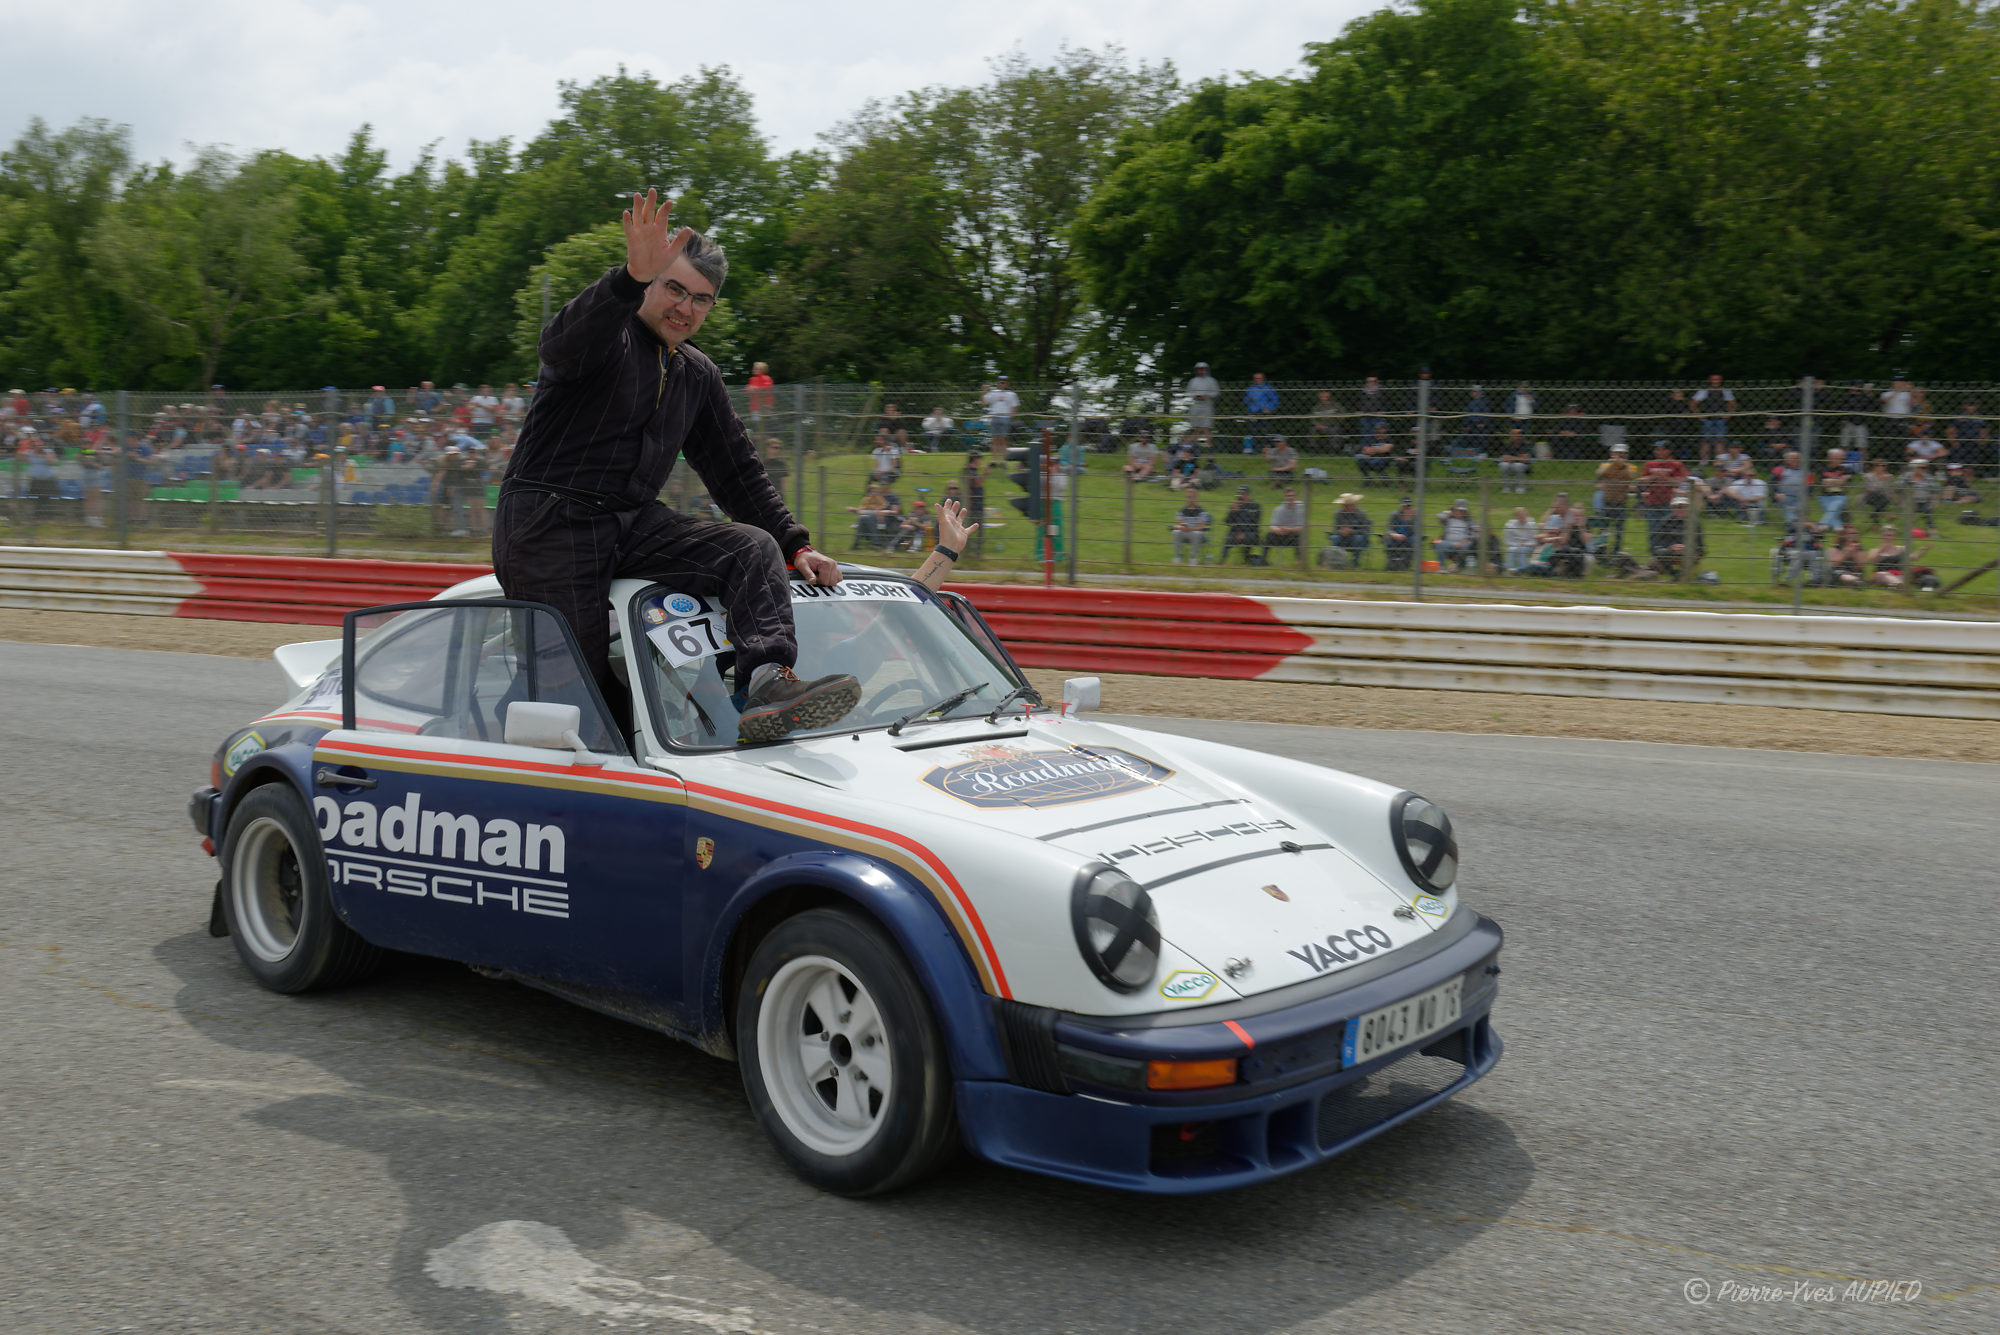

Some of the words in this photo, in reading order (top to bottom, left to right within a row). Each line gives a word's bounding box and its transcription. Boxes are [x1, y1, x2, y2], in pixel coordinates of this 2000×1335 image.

[846, 583, 911, 599] SPORT
[667, 617, 721, 657] 67
[960, 754, 1133, 793] Roadman
[1286, 925, 1392, 973] YACCO
[1165, 975, 1213, 995] YACCO
